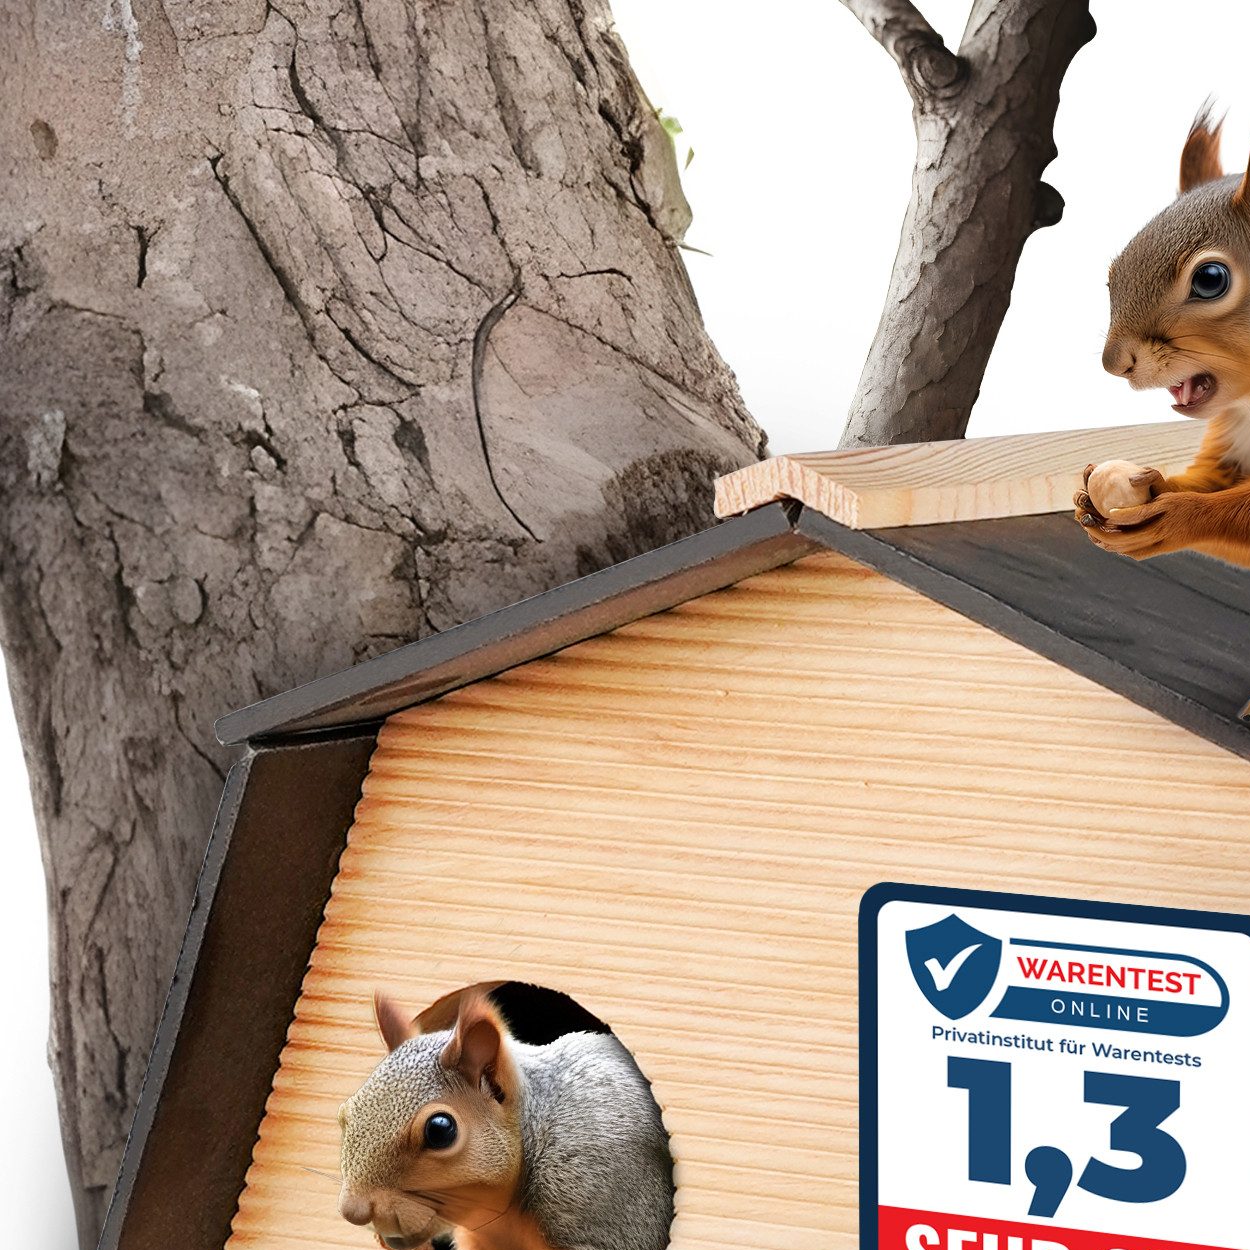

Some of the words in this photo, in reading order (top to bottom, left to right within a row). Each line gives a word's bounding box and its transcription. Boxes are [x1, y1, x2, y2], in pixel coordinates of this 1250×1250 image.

[1017, 956, 1201, 995] WARENTEST
[1051, 999, 1149, 1023] ONLINE
[932, 1026, 1053, 1052] Privatinstitut
[1059, 1039, 1085, 1055] für
[1092, 1043, 1201, 1067] Warentests
[947, 1056, 1187, 1218] 1,3
